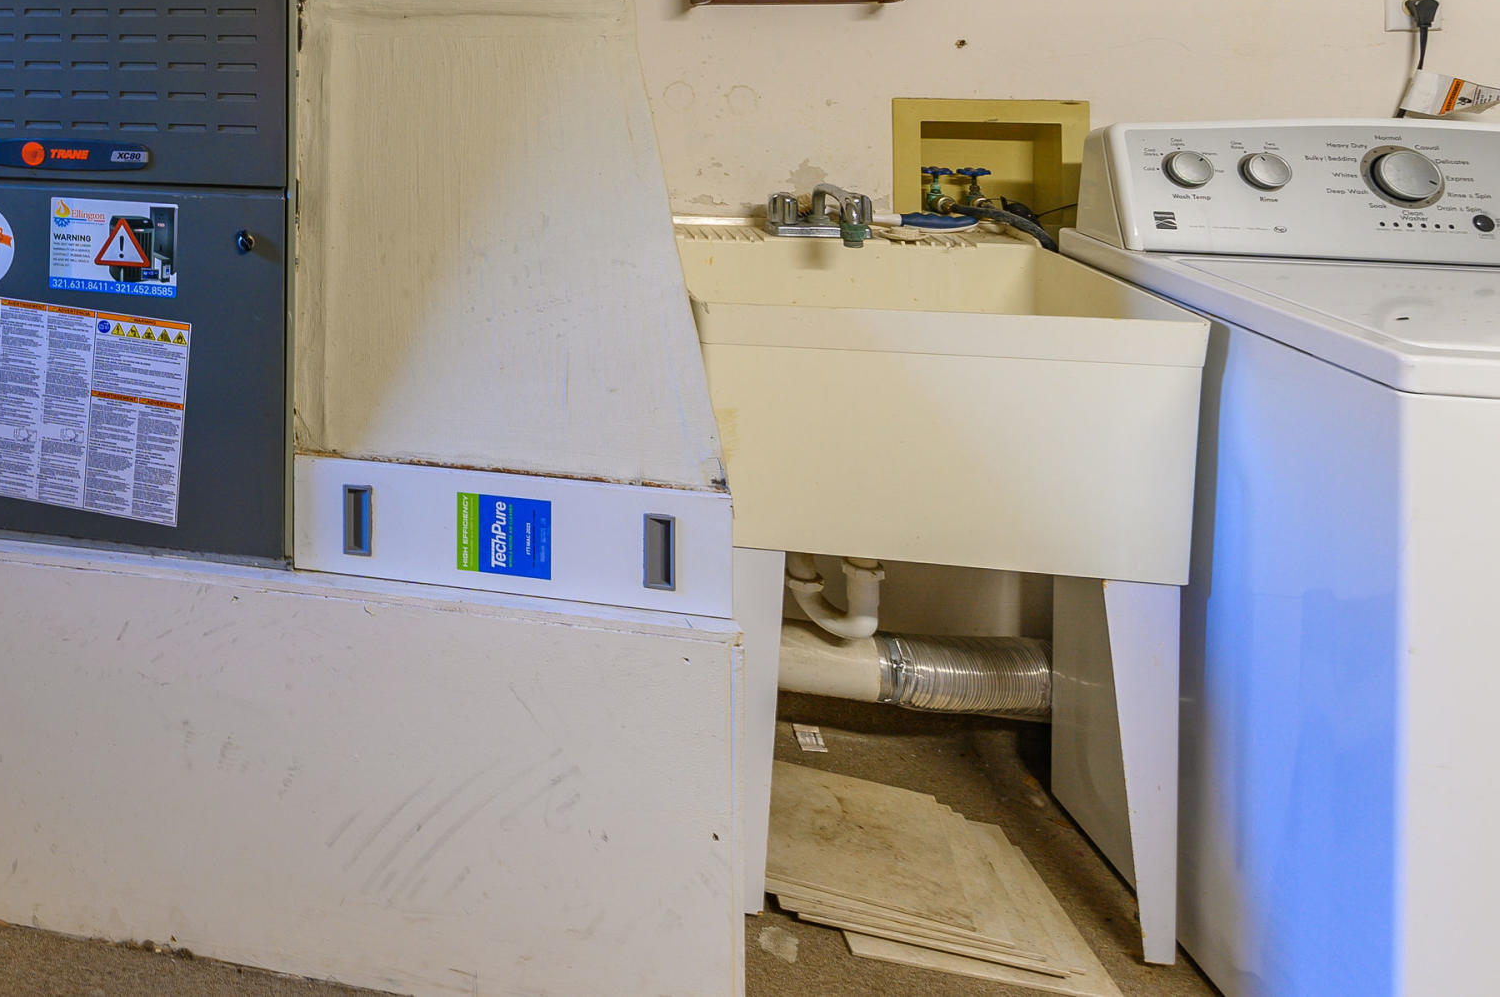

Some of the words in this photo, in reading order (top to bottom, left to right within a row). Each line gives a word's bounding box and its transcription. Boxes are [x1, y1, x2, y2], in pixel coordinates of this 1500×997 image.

[50, 149, 89, 160] TRANE
[117, 152, 141, 160] XC80
[71, 209, 105, 222] Ellington
[53, 233, 91, 243] WARNING
[52, 278, 108, 290] 321.631.8411
[116, 284, 173, 296] 321.452.8585
[491, 501, 507, 568] TechPure
